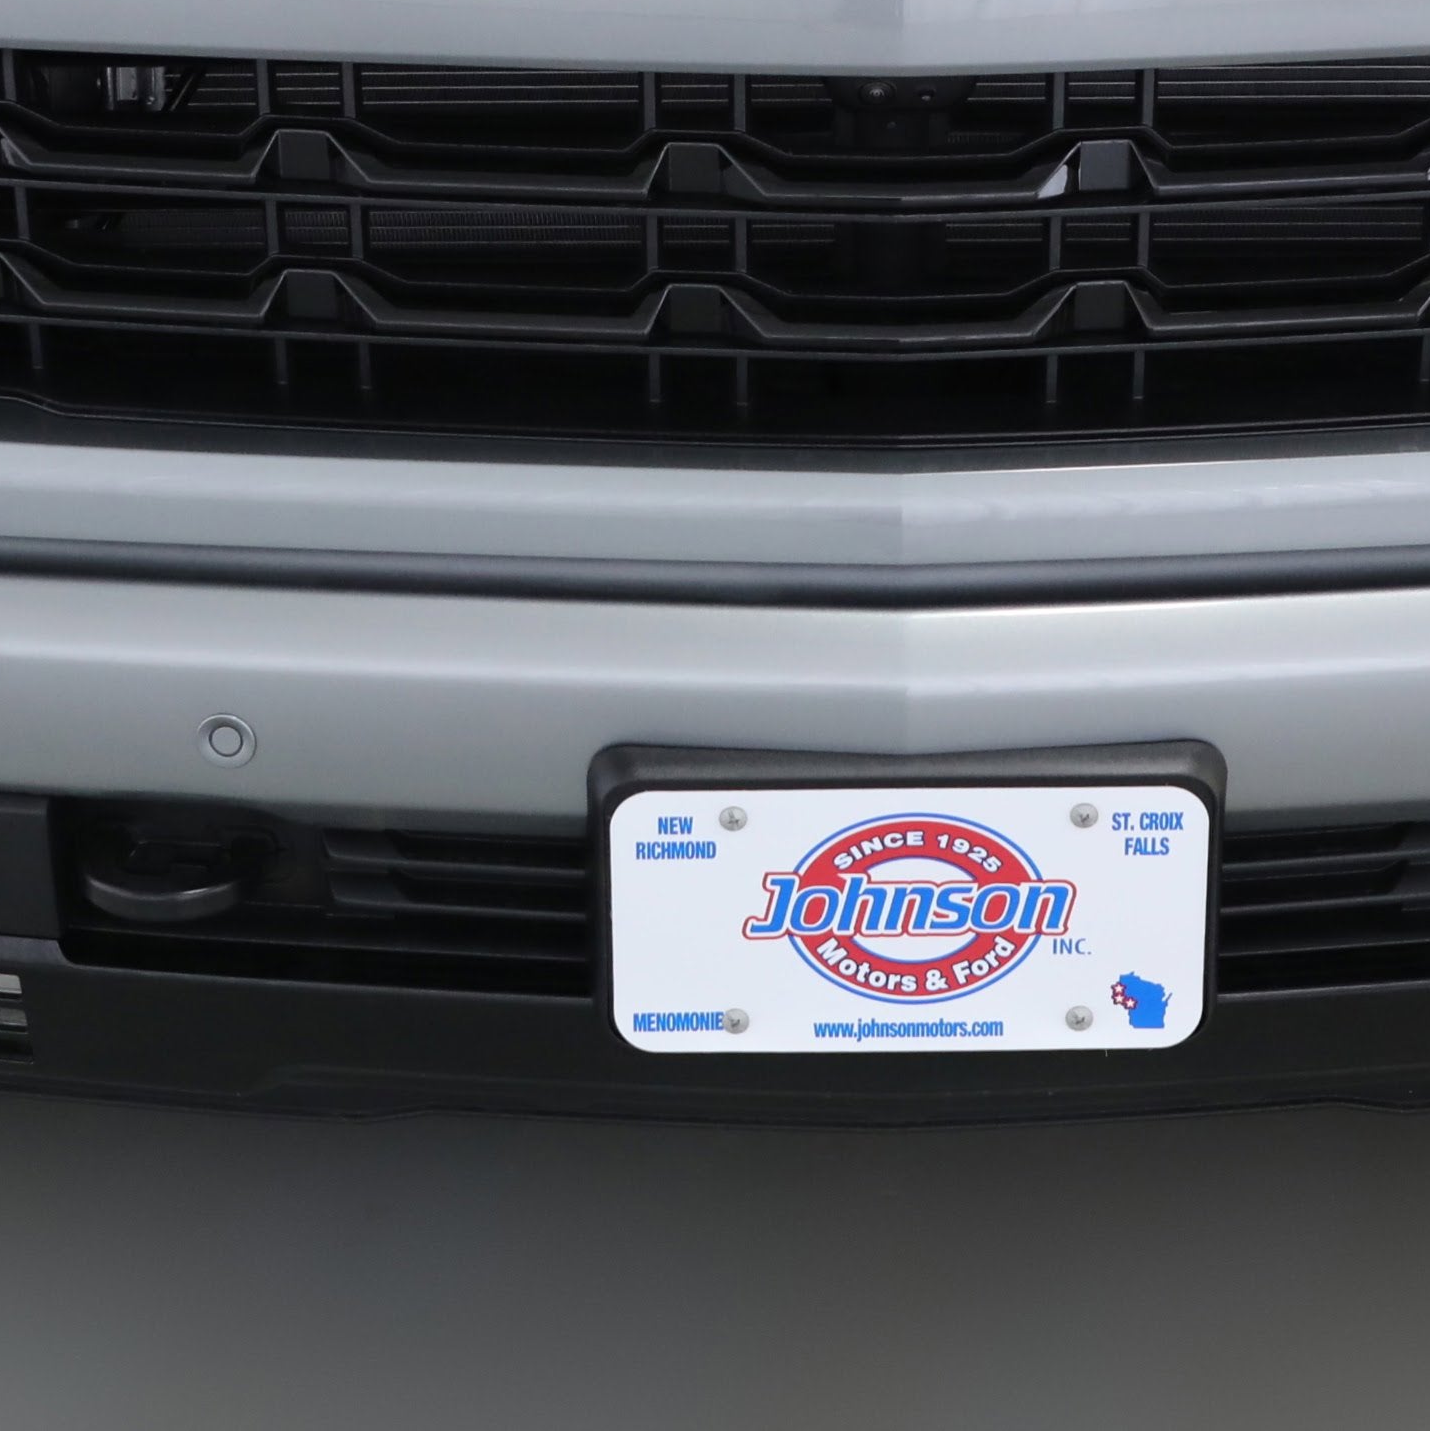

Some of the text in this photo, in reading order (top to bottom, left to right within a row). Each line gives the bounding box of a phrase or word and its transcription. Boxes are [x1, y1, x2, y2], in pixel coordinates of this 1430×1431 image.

[657, 816, 694, 836] NEW
[1111, 811, 1184, 831] ST. CROIX
[635, 840, 717, 860] RICHMOND
[832, 830, 1002, 874] SINCE 1925
[1124, 836, 1170, 857] FALLS
[747, 874, 1072, 936] Johnson
[1052, 938, 1092, 955] INC.
[816, 935, 1017, 993] Motors & Ford
[633, 1011, 725, 1032] MENOMONIE
[813, 1017, 1004, 1042] www.johnsonmotors.com
